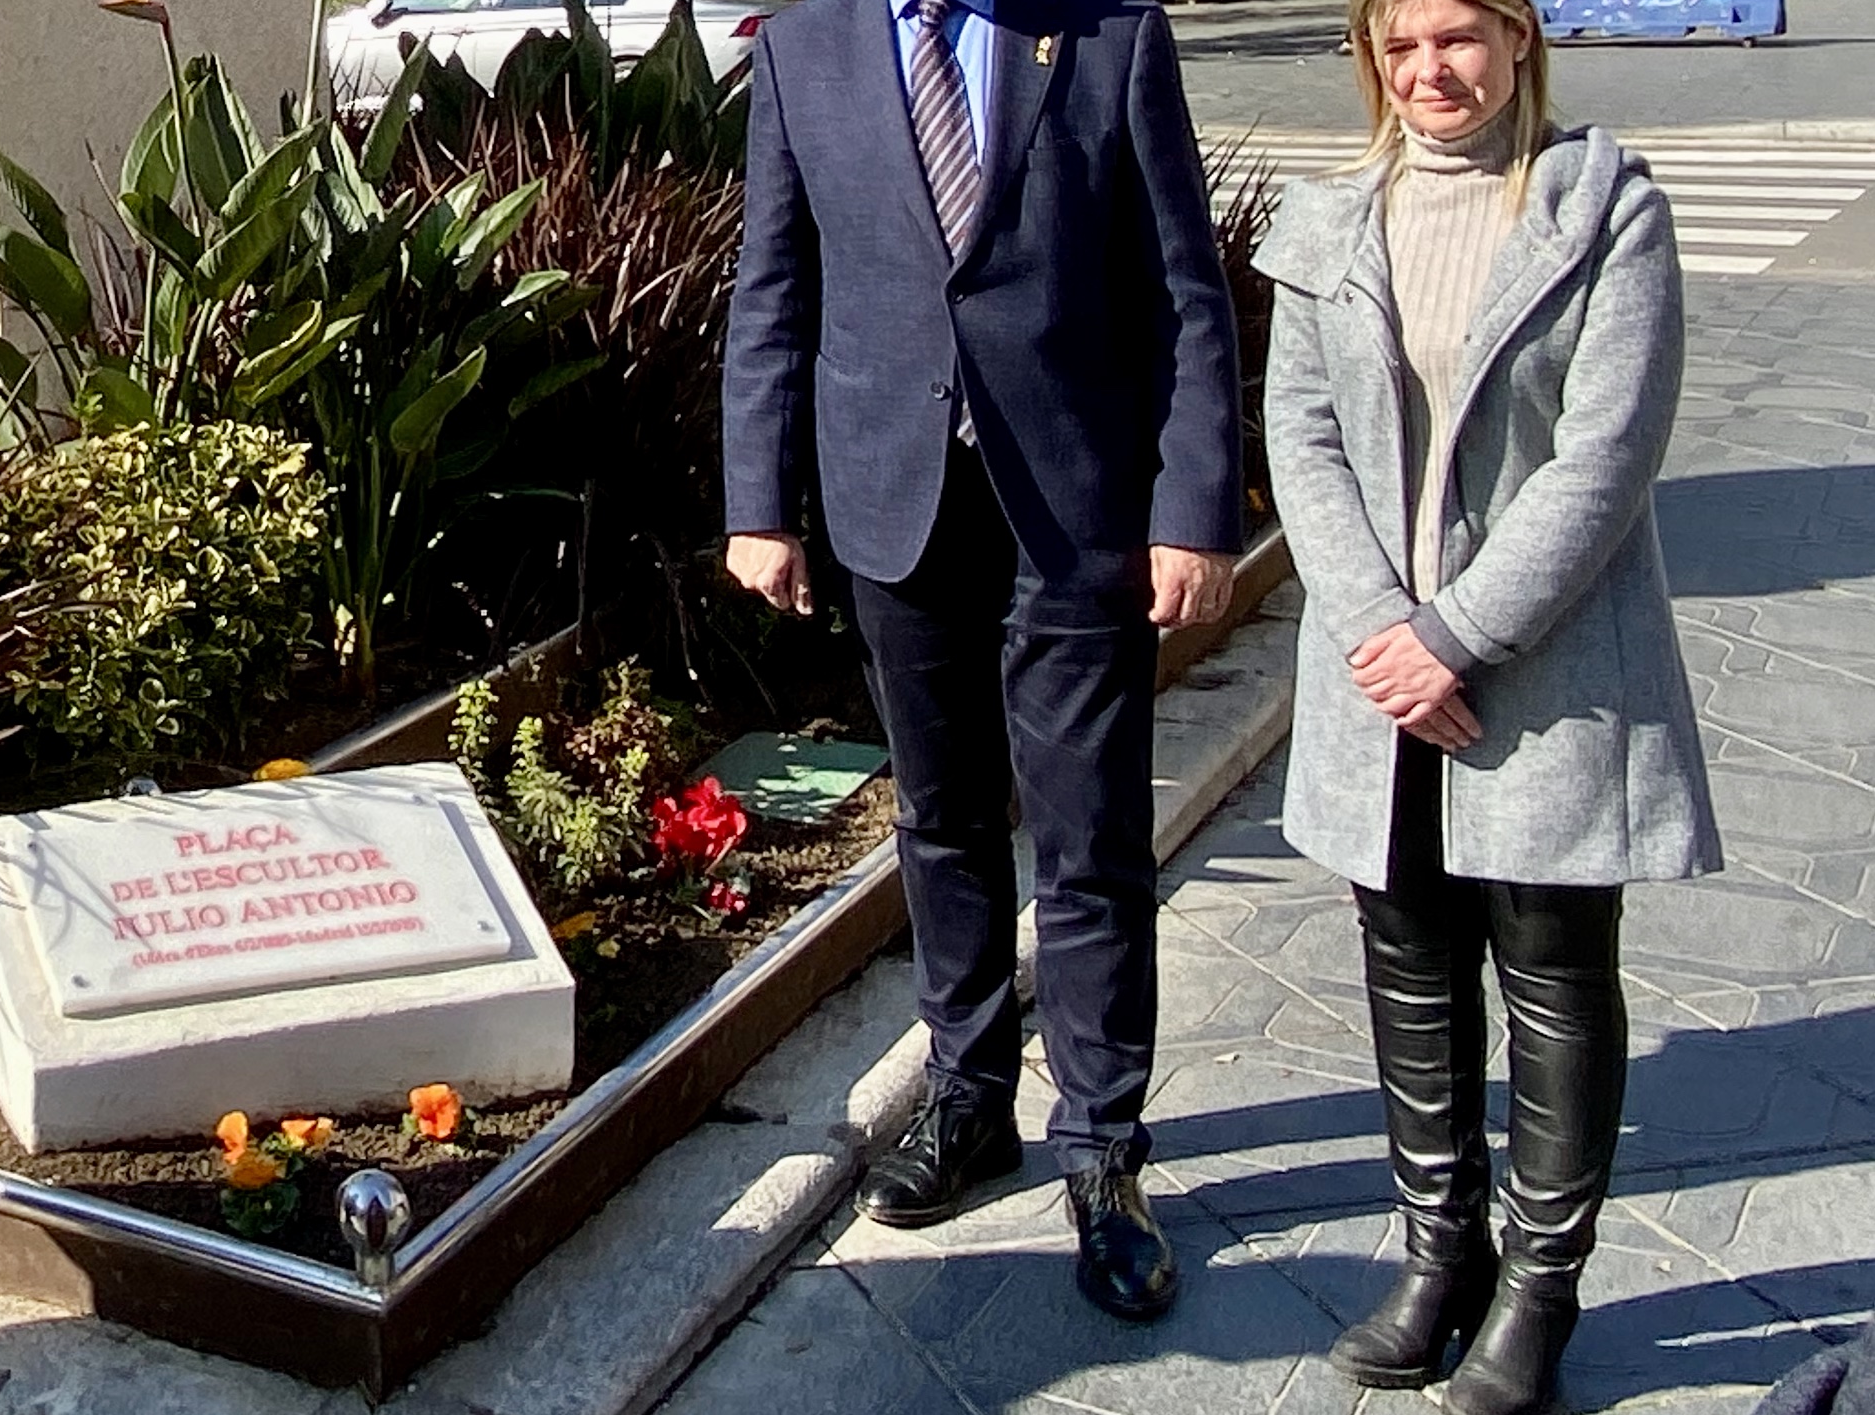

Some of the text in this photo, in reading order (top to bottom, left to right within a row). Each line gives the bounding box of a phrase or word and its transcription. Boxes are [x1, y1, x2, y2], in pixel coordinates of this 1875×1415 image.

[173, 824, 300, 857] PLAÇA
[110, 848, 392, 903] DE L'ESCULTOR
[240, 880, 418, 924] ANTONIO
